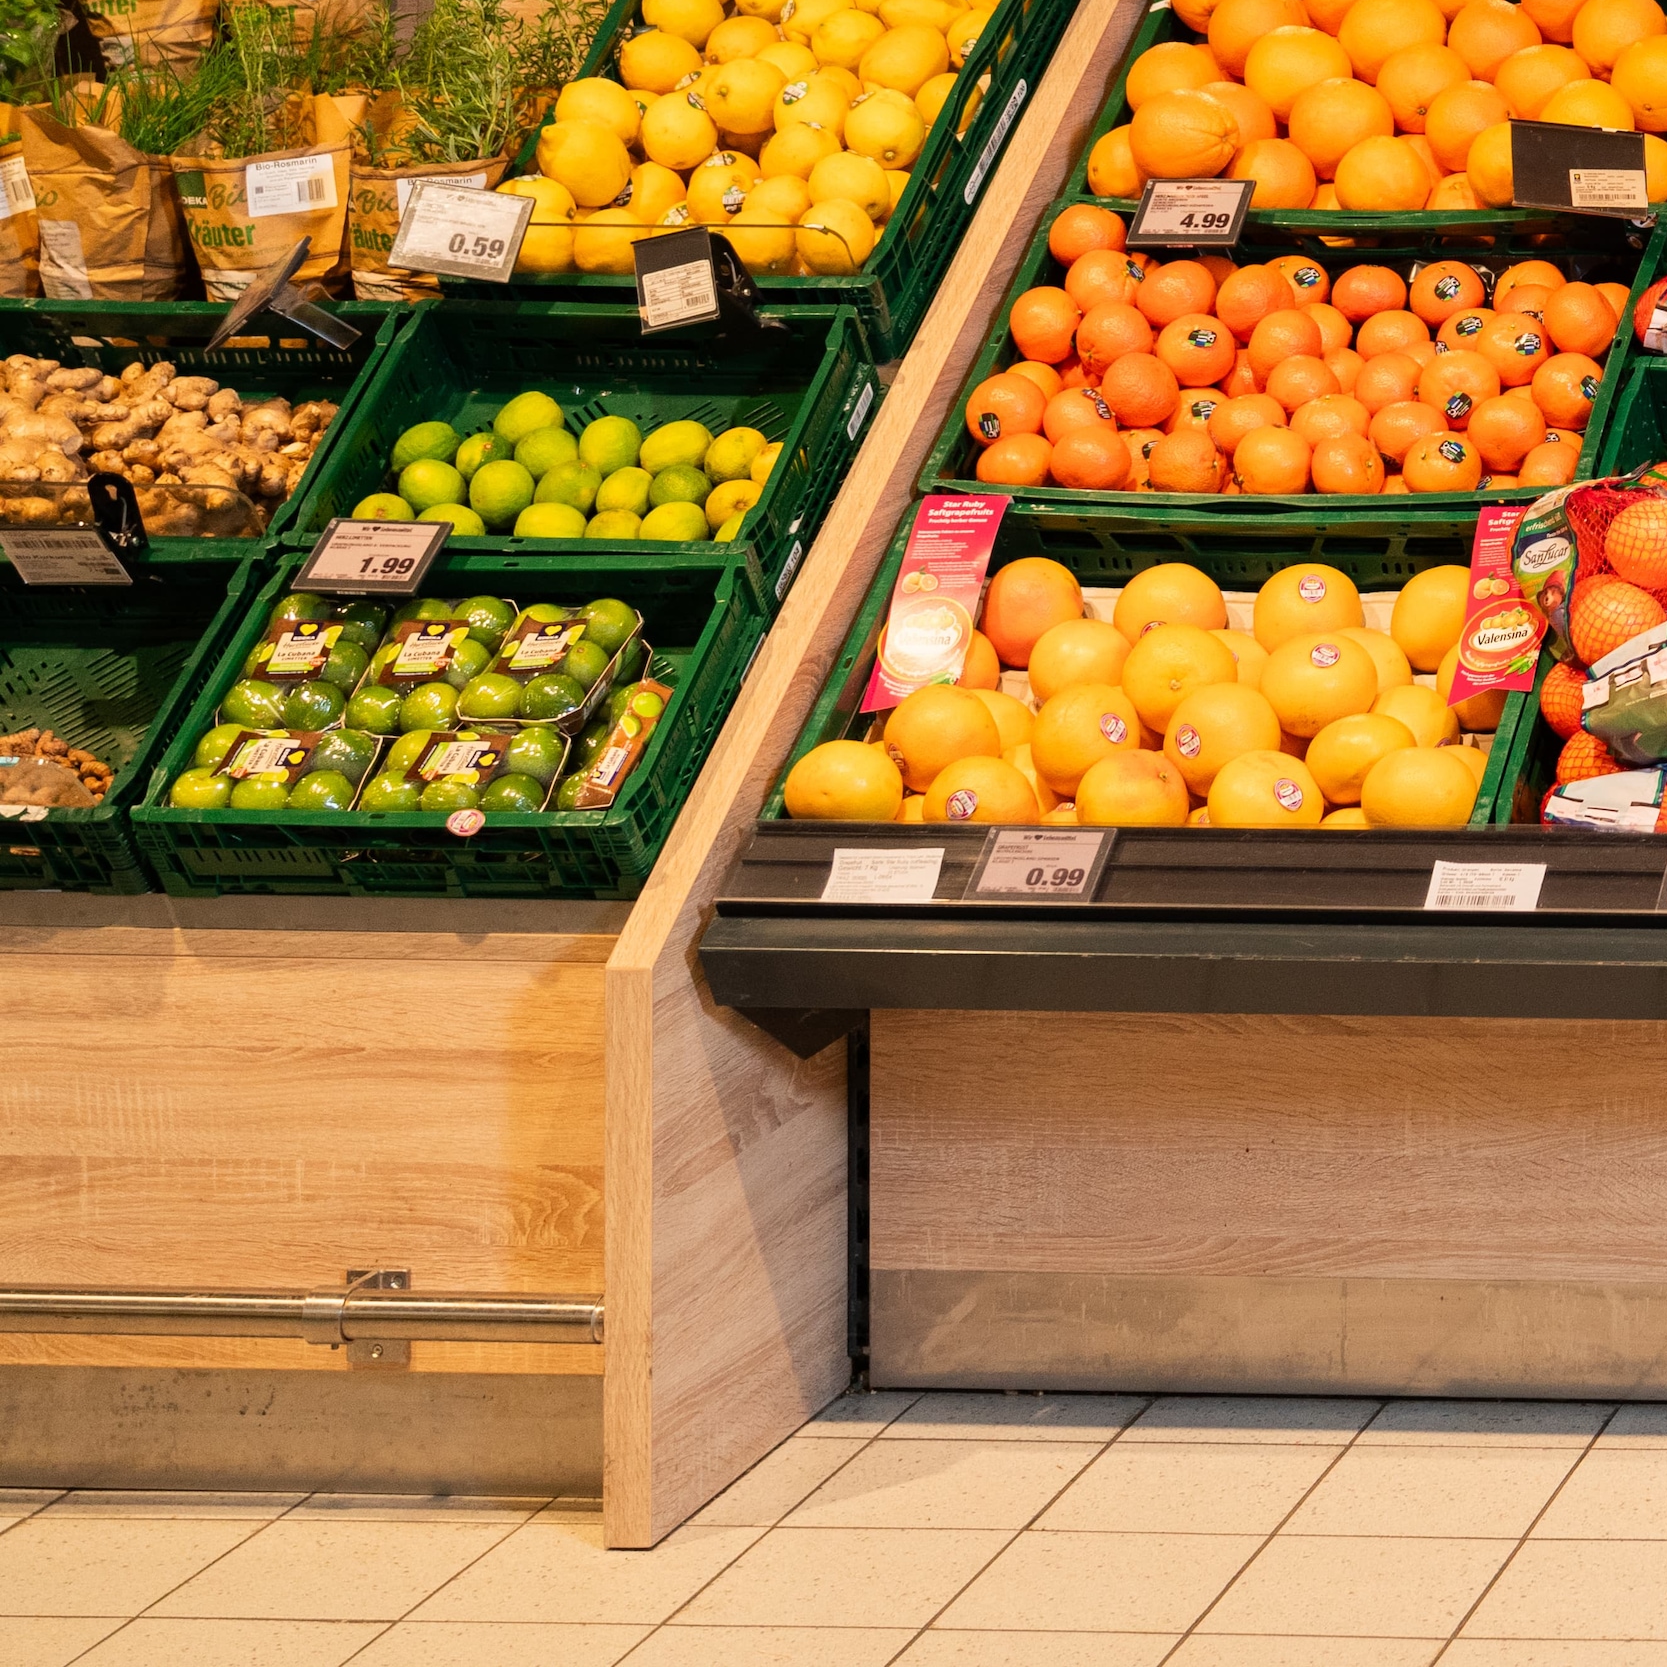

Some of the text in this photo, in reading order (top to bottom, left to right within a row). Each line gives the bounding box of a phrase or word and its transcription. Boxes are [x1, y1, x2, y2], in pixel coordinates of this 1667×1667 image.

[255, 156, 317, 171] Bio-Rosmarin
[1180, 213, 1230, 228] 4.99
[448, 234, 504, 259] 0.59
[928, 508, 994, 517] Saftgrapefruits
[944, 500, 985, 509] Star Ruby
[1524, 543, 1569, 568] SanLucar
[360, 556, 415, 575] 1.99
[1478, 629, 1528, 645] Valensina
[1025, 868, 1084, 886] 0.99
